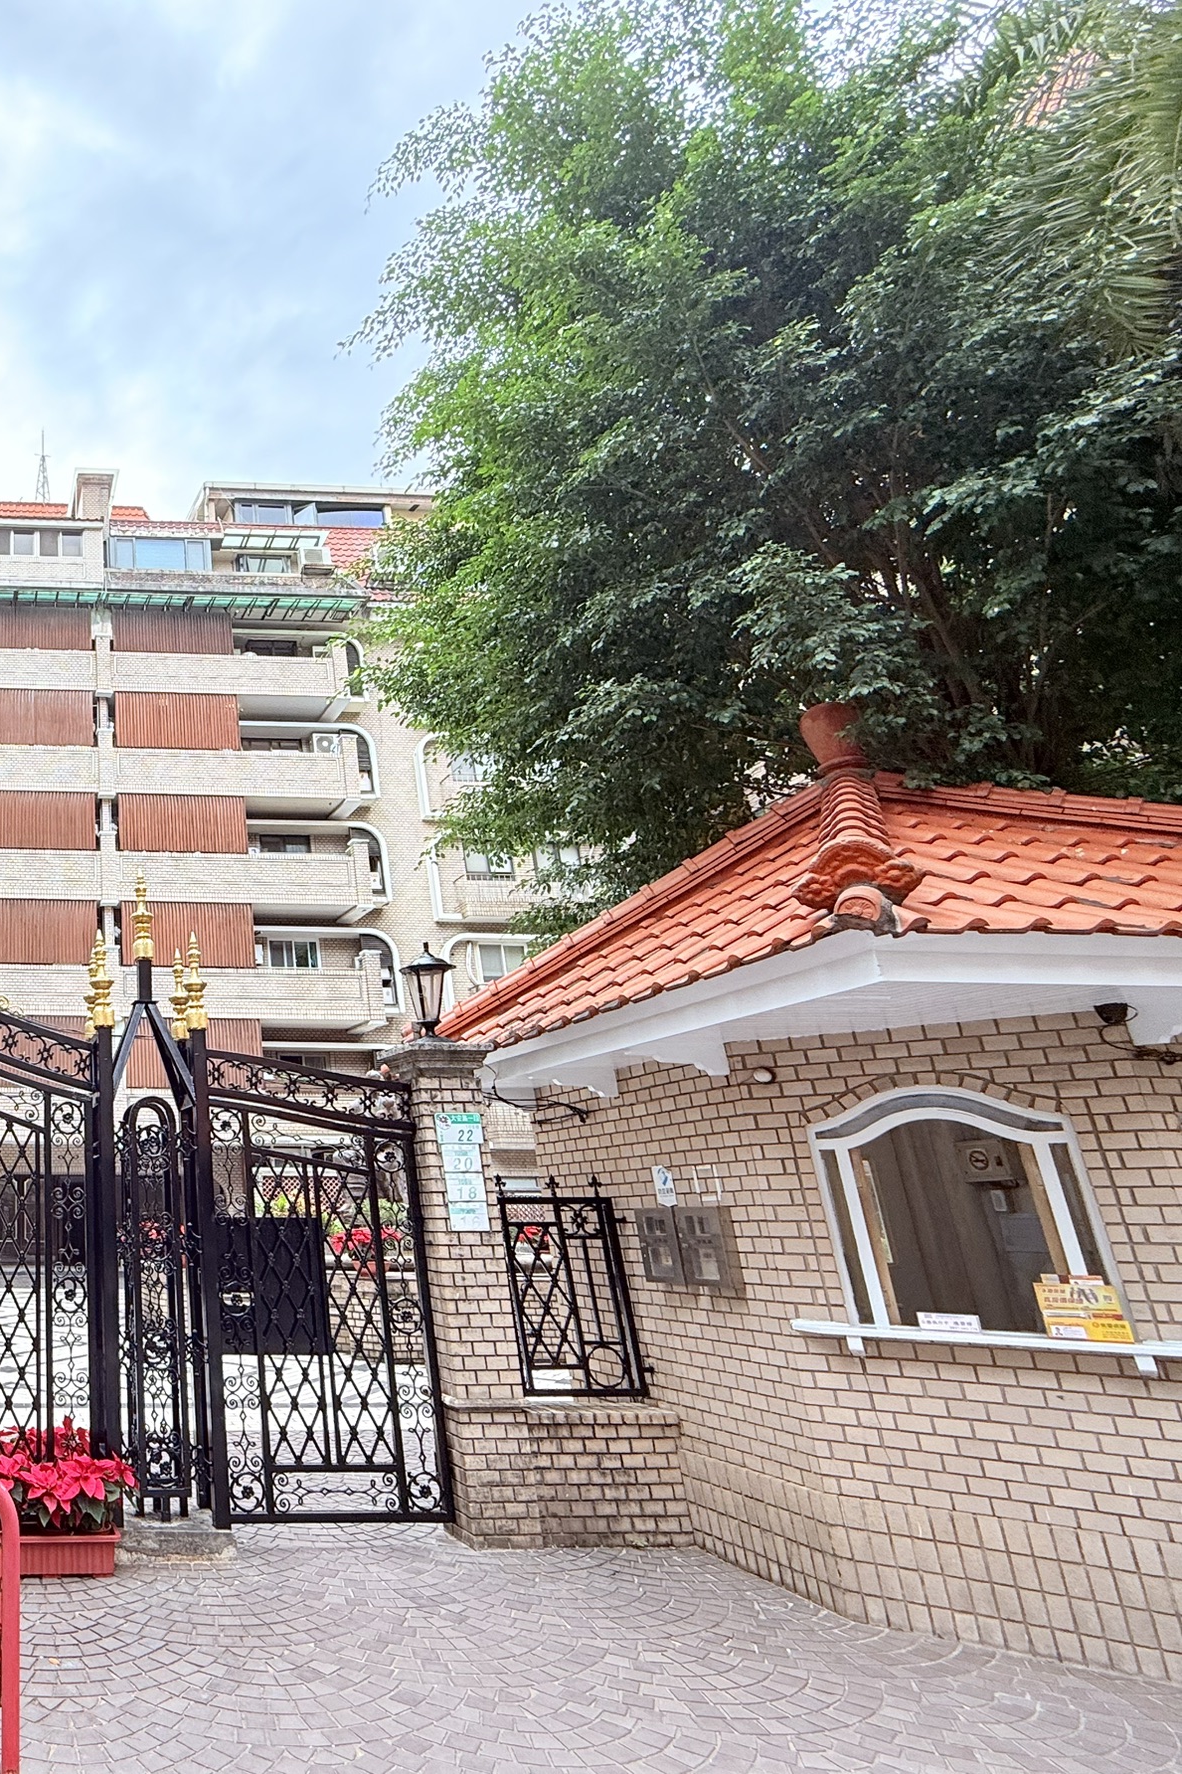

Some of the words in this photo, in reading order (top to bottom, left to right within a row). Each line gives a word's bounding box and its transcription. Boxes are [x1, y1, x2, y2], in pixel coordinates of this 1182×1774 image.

[458, 1129, 474, 1142] 22
[453, 1157, 473, 1170] 20
[457, 1186, 477, 1200] 18
[460, 1216, 481, 1229] 16
